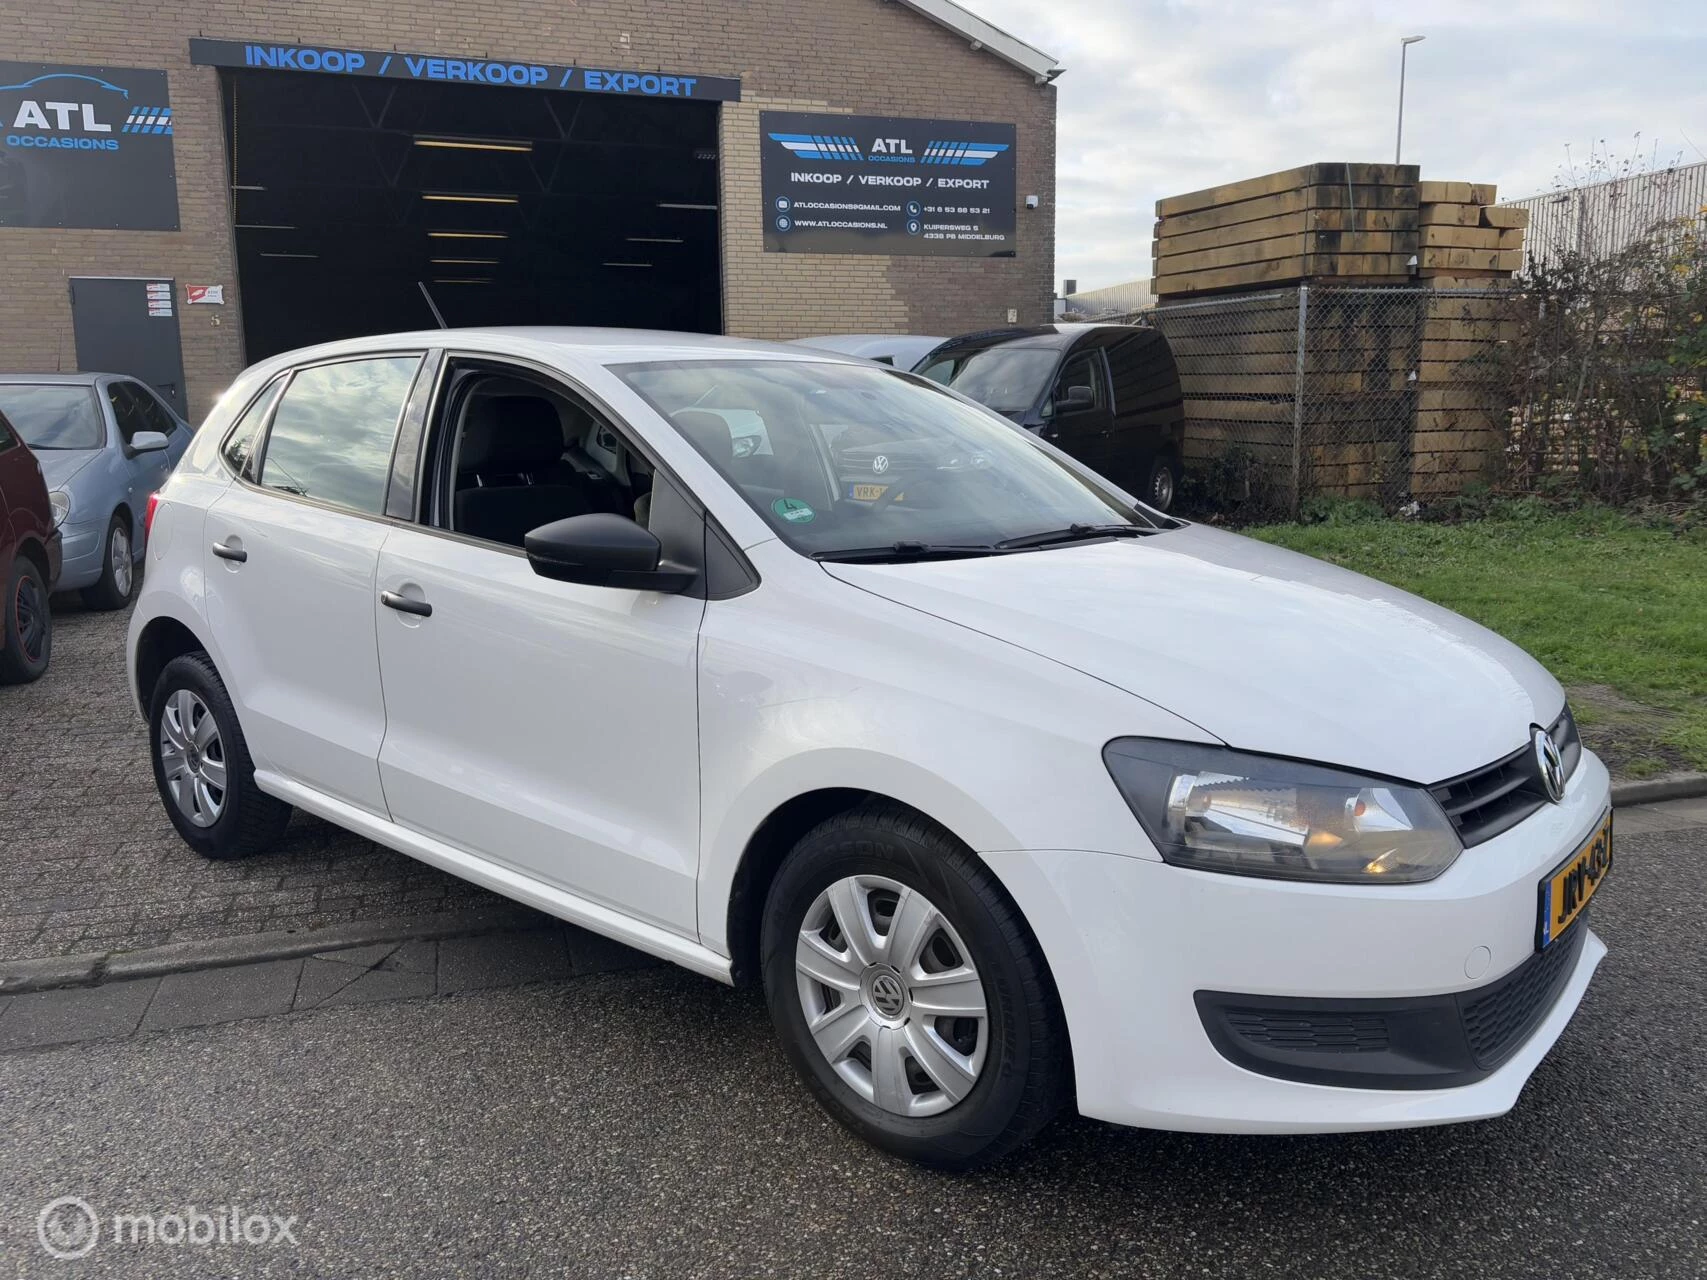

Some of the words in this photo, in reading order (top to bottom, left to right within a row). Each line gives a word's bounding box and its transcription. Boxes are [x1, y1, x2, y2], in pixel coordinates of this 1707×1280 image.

[246, 45, 366, 73] INKOOP
[378, 56, 392, 76] /
[404, 57, 549, 85] VERKOOP
[559, 68, 573, 88] /
[583, 71, 697, 97] EXPORT
[13, 100, 112, 132] ATL
[5, 134, 120, 151] OCCASIONS
[871, 138, 913, 154] ATL
[867, 155, 916, 164] OCCASIONS
[790, 171, 842, 184] INKOOP
[858, 174, 922, 188] VERKOOP
[937, 177, 990, 190] EXPORT
[793, 201, 901, 212] ATLOCCASIONS@GMAIL.COM
[794, 219, 888, 230] WWW.ATLOCCASIONS.NL
[957, 233, 1005, 242] MIDDELBURG
